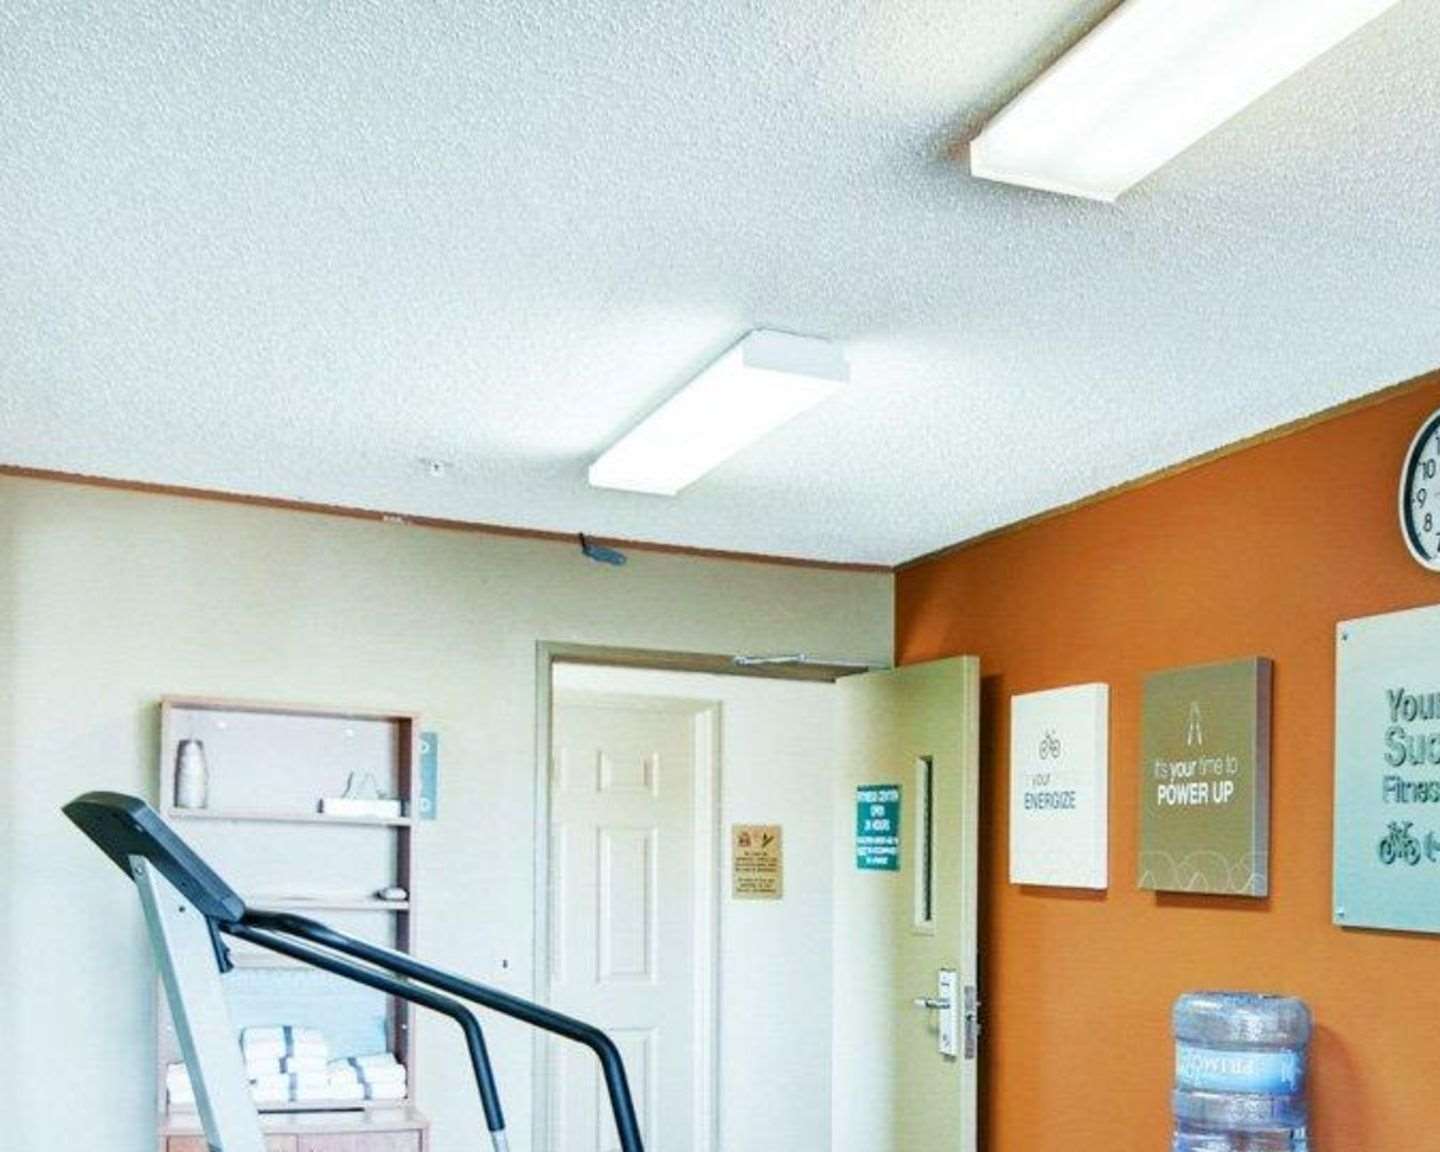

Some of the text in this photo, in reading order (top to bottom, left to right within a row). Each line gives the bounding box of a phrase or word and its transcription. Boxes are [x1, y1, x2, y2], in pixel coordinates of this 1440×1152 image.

[1422, 458, 1436, 480] 10
[1416, 488, 1427, 509] 9
[1423, 513, 1433, 532] 8
[1168, 761, 1197, 785] your
[1226, 753, 1238, 774] to
[1024, 790, 1076, 811] ENERGIZE
[1158, 780, 1234, 806] POWER UP
